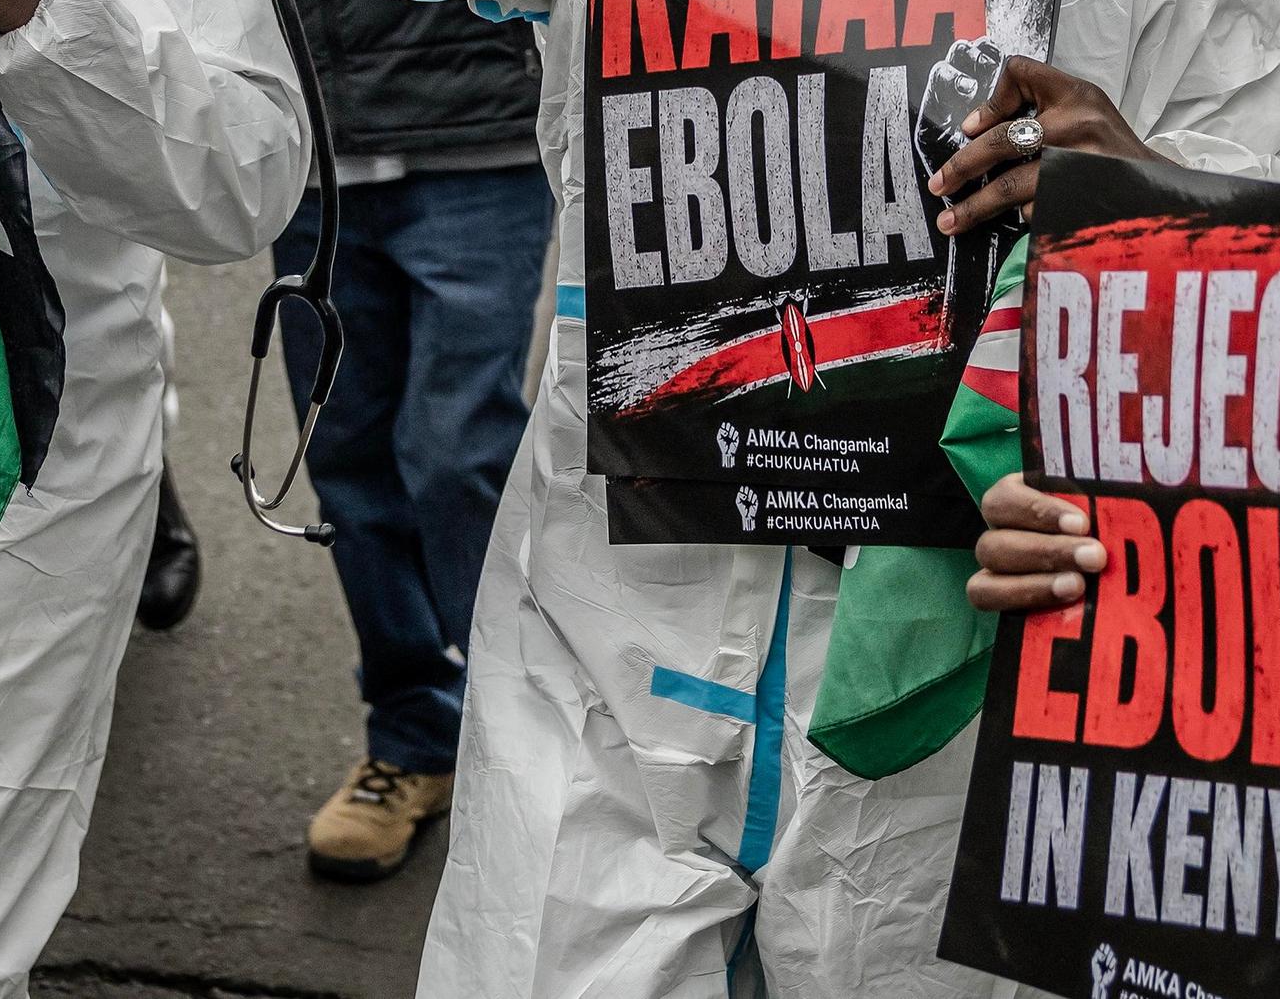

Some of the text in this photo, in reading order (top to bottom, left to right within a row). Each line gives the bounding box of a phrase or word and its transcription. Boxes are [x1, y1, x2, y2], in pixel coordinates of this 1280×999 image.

[601, 65, 934, 291] EBOLA
[746, 428, 890, 455] AMKA Changamka!
[746, 454, 860, 473] #CHUKUAHATUA
[765, 491, 909, 512] AMKA Changamka!
[766, 516, 880, 530] #CHUKUAHATUA
[1000, 761, 1090, 910] IN
[1122, 958, 1180, 999] AMKA
